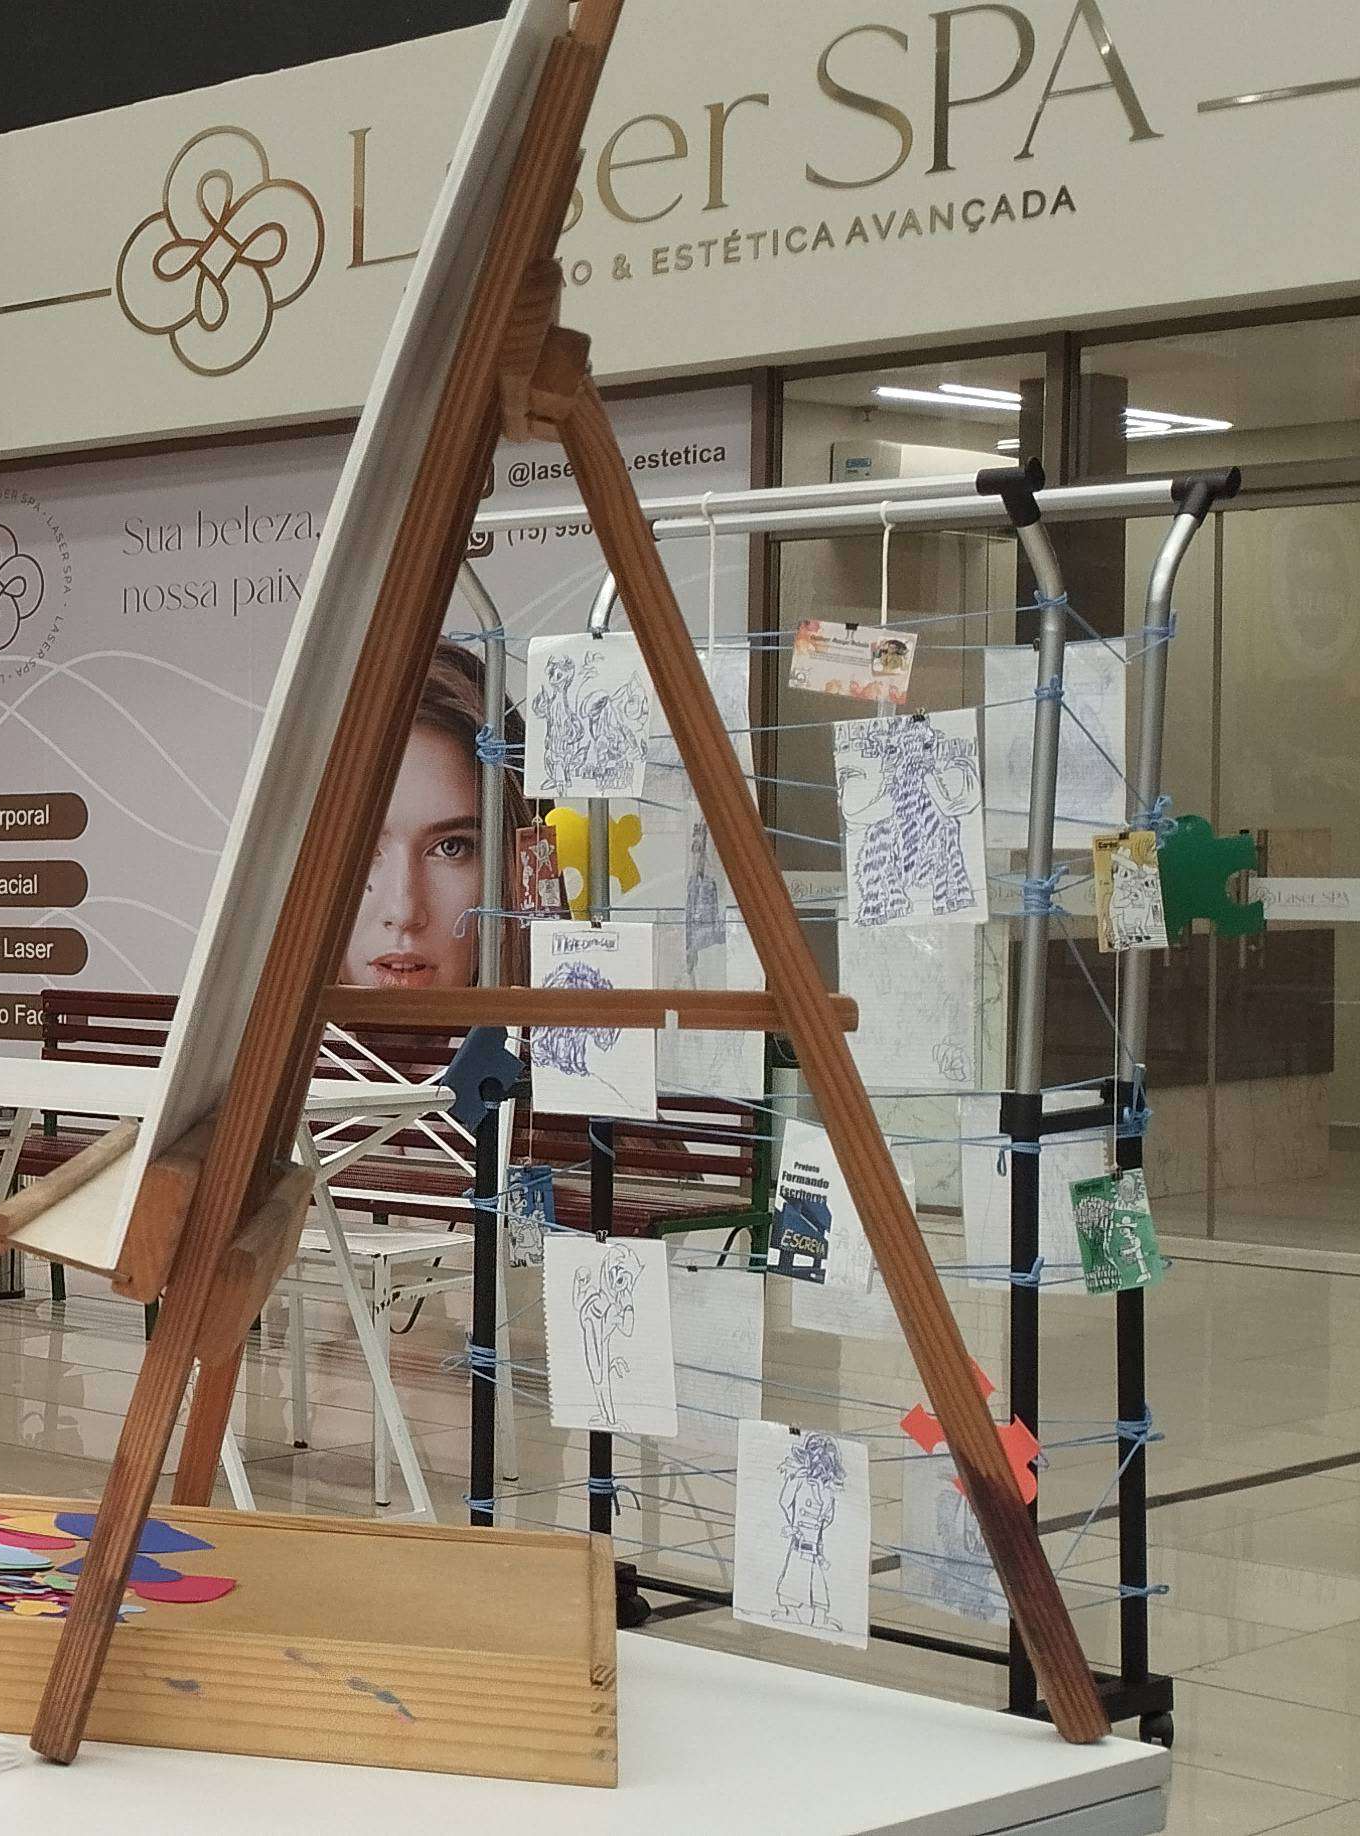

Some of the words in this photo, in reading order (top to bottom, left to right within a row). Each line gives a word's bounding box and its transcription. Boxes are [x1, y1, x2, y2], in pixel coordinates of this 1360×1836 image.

[805, 0, 1164, 190] SPA
[652, 220, 833, 276] ESTÉTICA
[845, 184, 1077, 248] AVANÇADA
[123, 516, 182, 556] Sua
[123, 579, 217, 614] nossa
[233, 567, 304, 617] paix
[3, 938, 54, 959] Laser
[780, 1184, 827, 1203] Escritores
[782, 1170, 829, 1189] Formando
